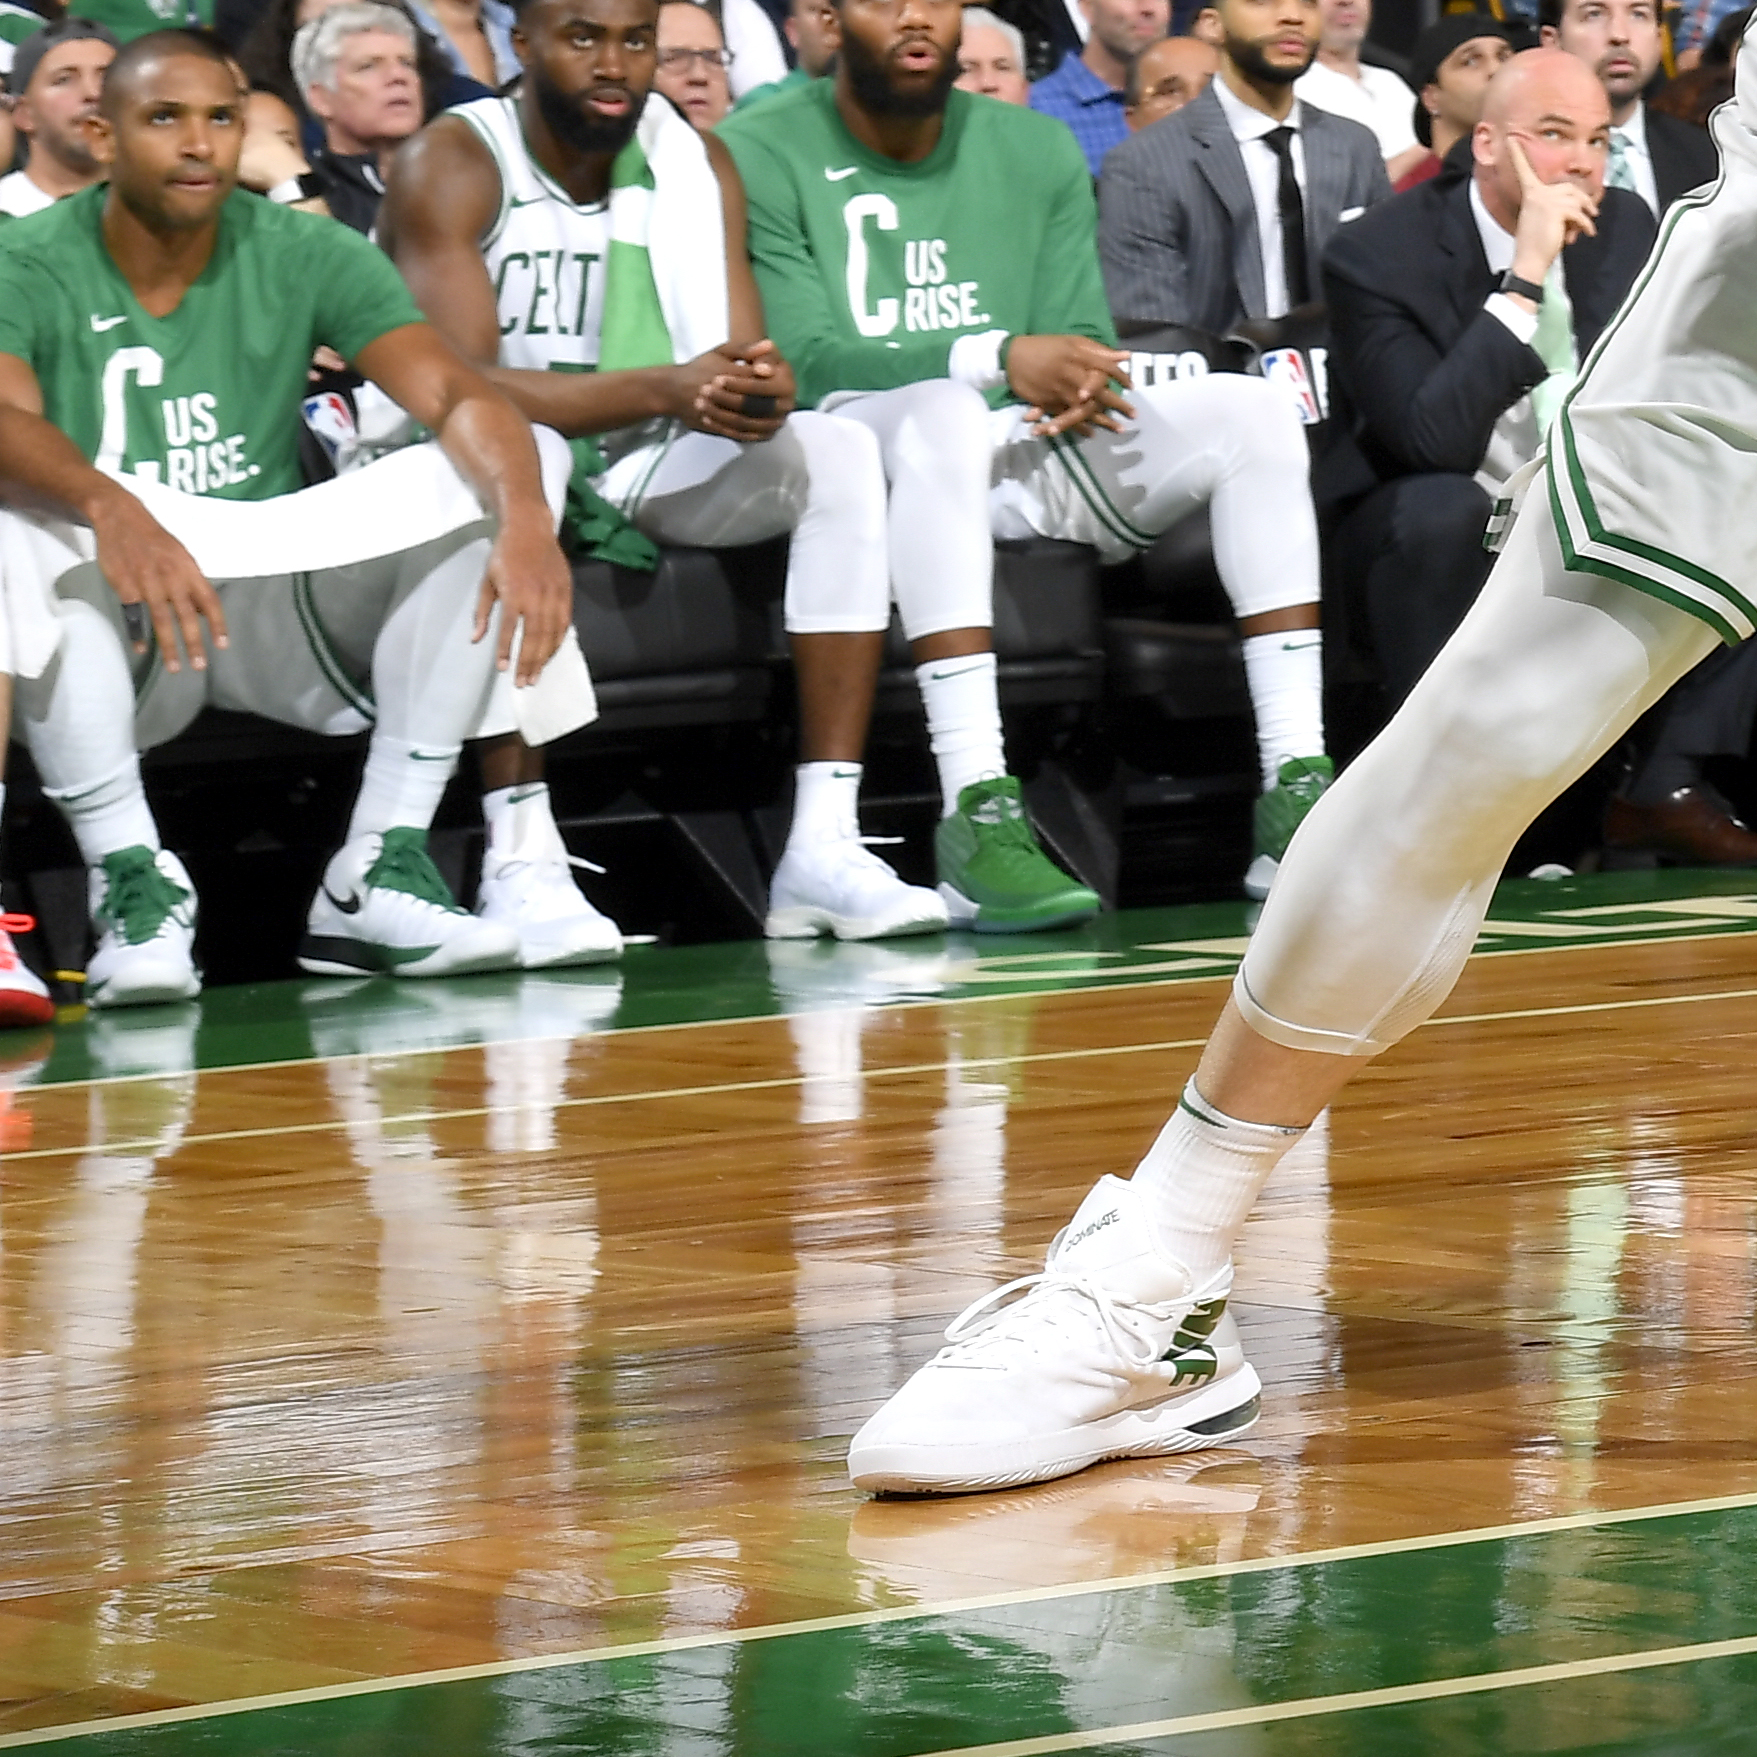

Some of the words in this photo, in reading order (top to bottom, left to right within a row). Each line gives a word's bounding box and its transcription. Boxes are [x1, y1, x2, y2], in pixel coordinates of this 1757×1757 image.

[904, 239, 946, 283] US
[498, 252, 601, 335] CELT
[904, 281, 990, 331] RISE.
[163, 393, 217, 447] US
[166, 435, 261, 493] RISE.
